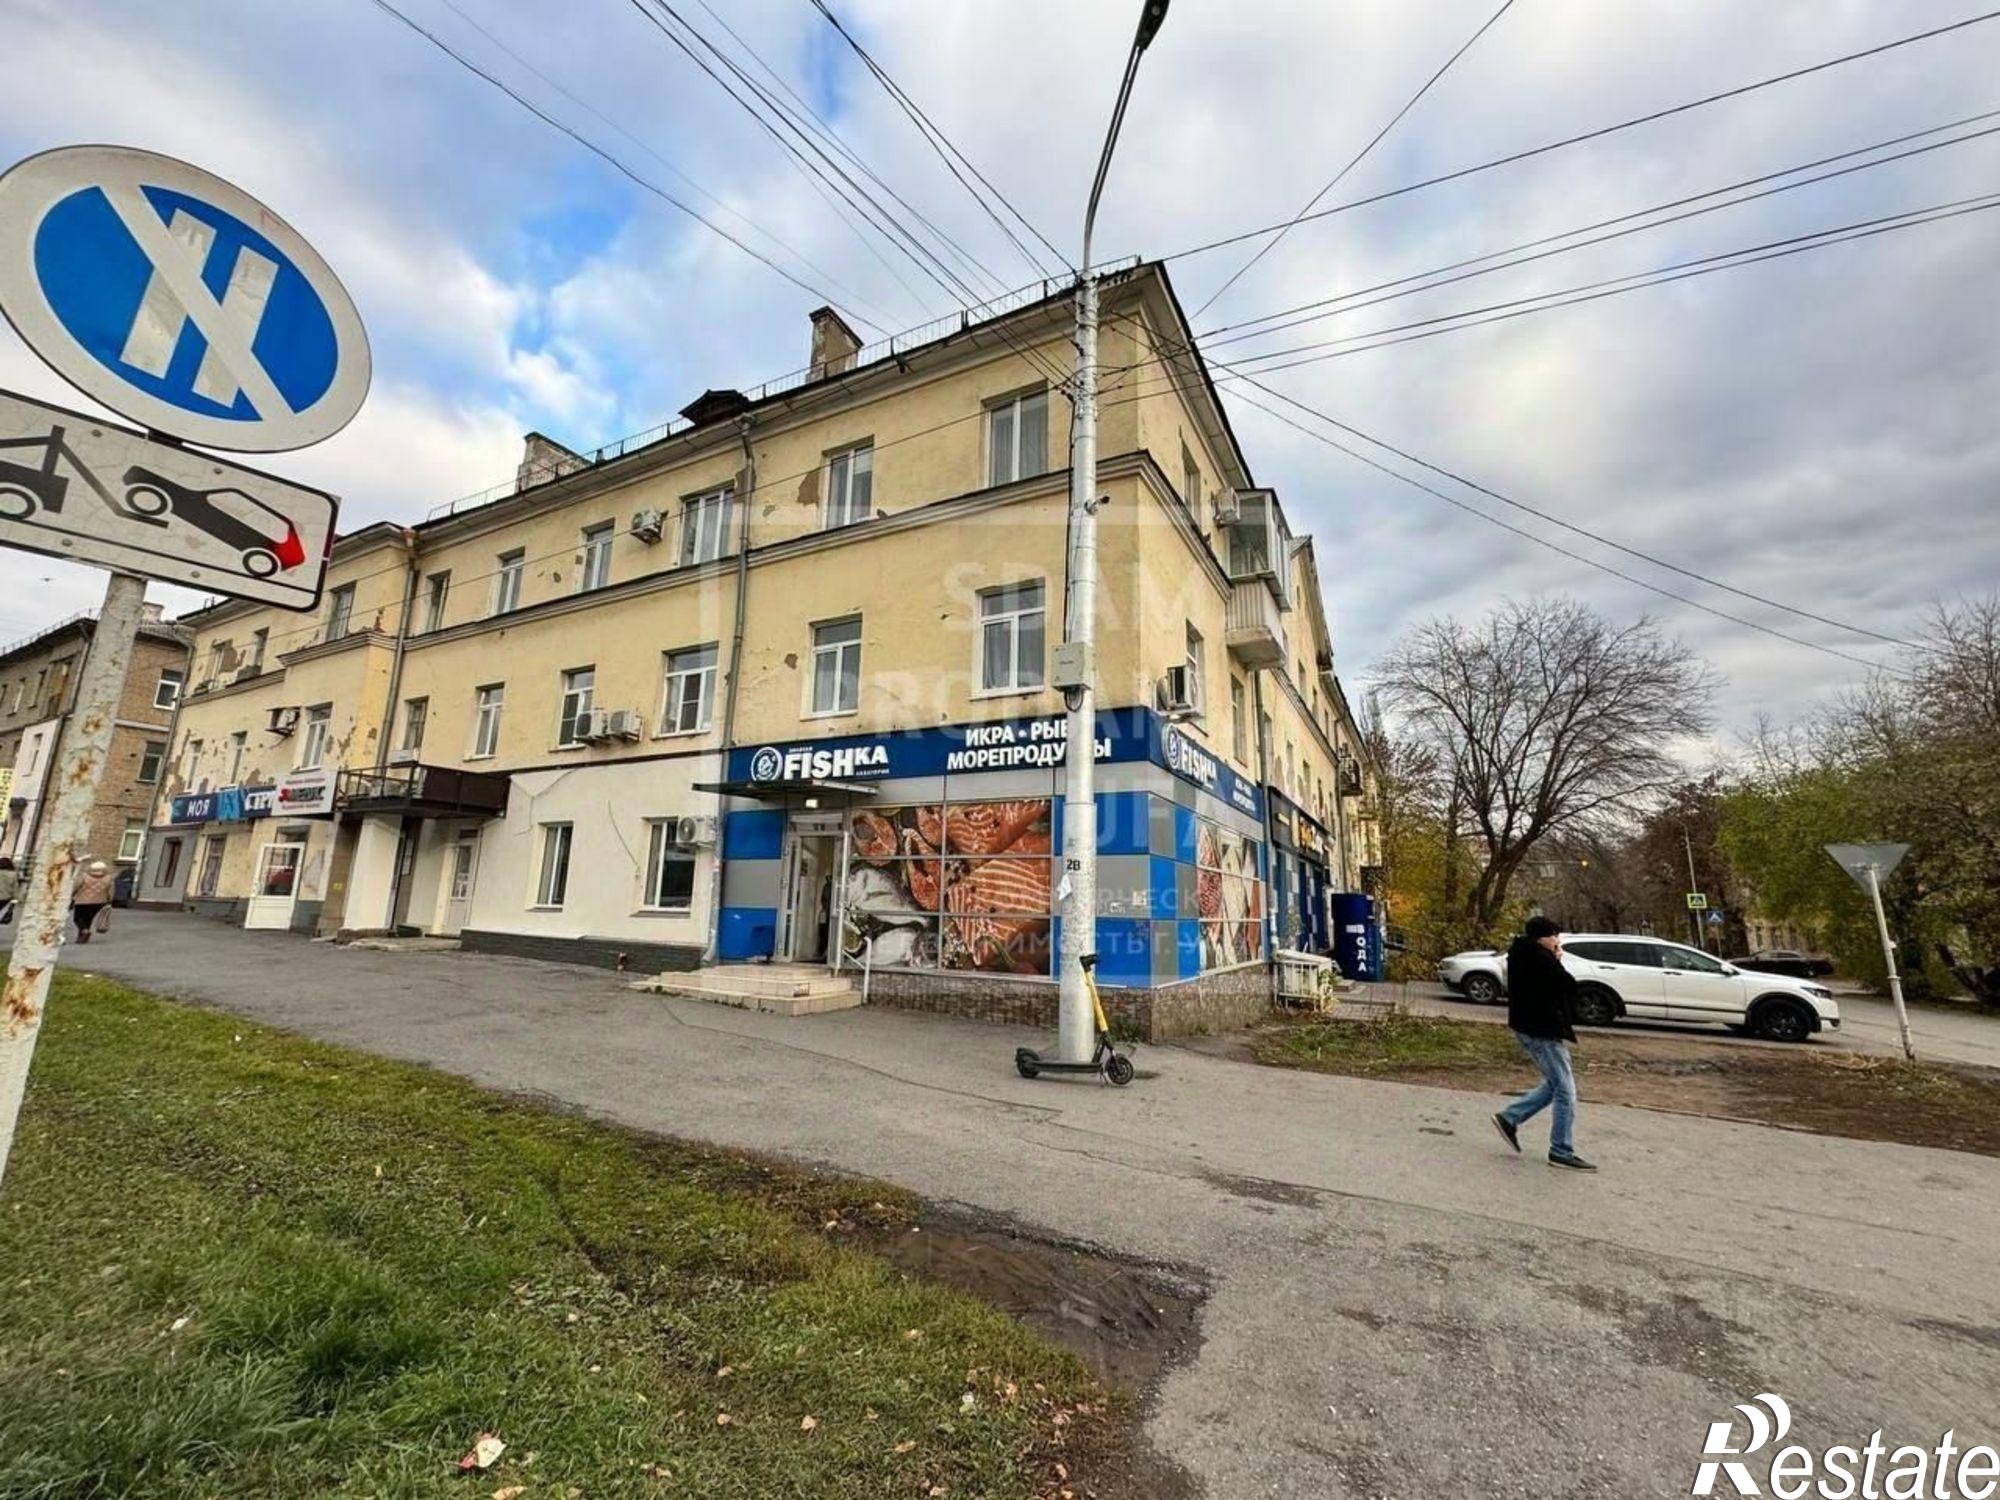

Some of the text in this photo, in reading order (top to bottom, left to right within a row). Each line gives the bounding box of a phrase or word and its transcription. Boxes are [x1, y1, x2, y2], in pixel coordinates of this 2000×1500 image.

[965, 725, 1015, 747] ИКРА
[947, 738, 1111, 770] МОРЕПРОДУЫ
[186, 799, 211, 817] МОЯ
[1356, 924, 1367, 972] ВОДА
